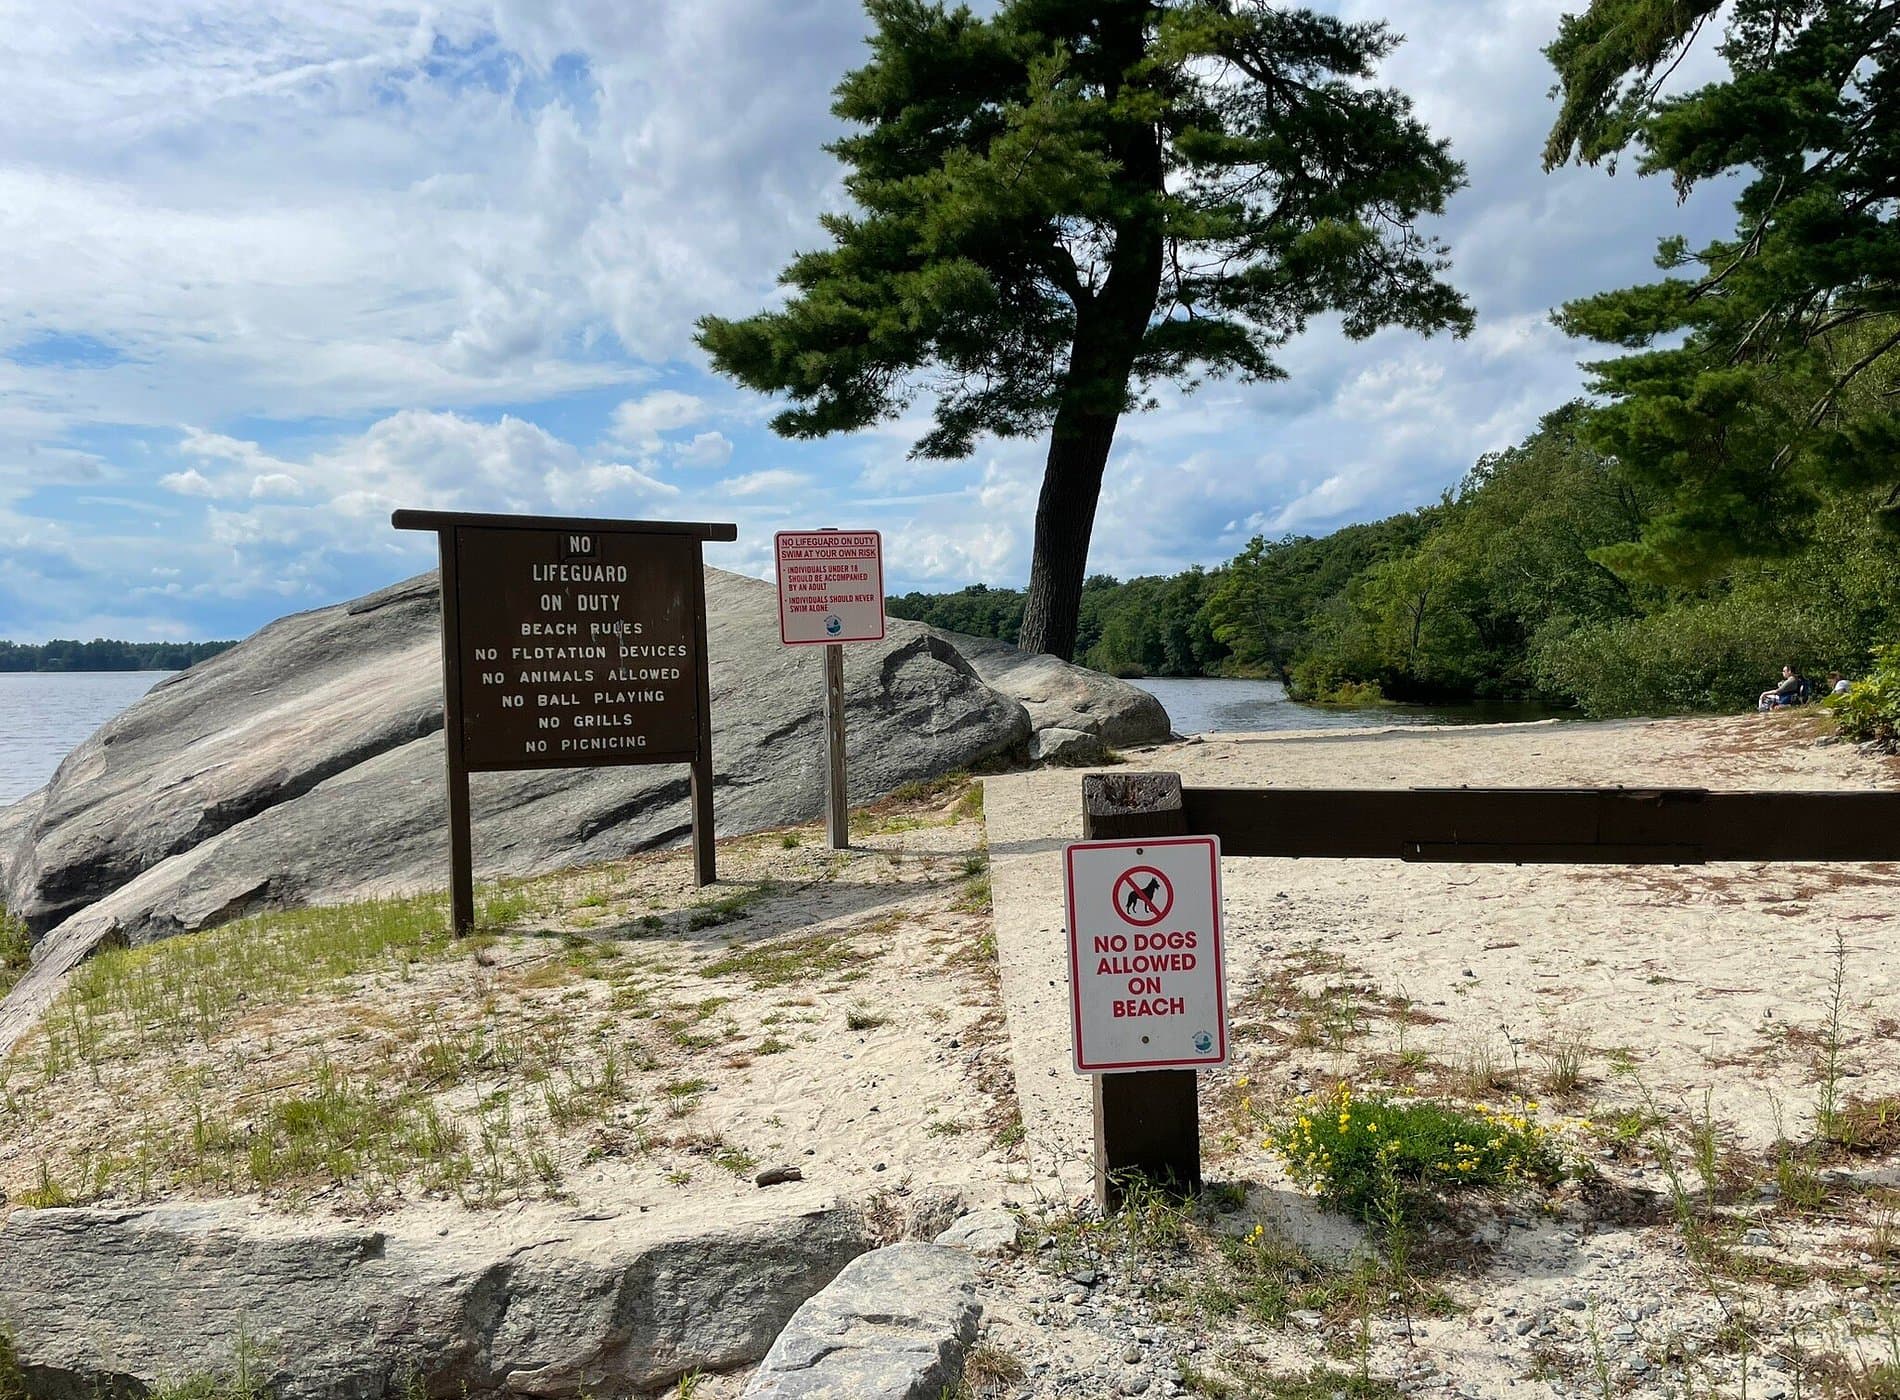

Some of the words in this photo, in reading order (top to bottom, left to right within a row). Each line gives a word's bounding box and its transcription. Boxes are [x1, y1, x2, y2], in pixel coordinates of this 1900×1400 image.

[570, 536, 591, 553] NO
[796, 537, 840, 546] LIFEGUARD
[533, 564, 627, 582] LIFEGUARD
[825, 573, 868, 581] ACCOMPANIED
[541, 594, 562, 611] ON
[578, 594, 620, 611] DUTY
[522, 623, 577, 635] BEACH
[591, 623, 642, 634] RULES
[476, 648, 497, 660] NO
[512, 646, 606, 659] FLOTATION
[619, 645, 687, 657] DEVICES
[482, 672, 504, 685] NO
[520, 670, 593, 683] ANIMALS
[608, 668, 680, 681] ALLOWED
[502, 695, 524, 707] NO
[538, 693, 580, 706] BALL
[595, 690, 664, 703] PLAYING
[538, 716, 559, 728] NO
[574, 714, 633, 727] GRILLS
[526, 740, 547, 752] NO
[561, 736, 646, 751] PICNICING
[1094, 935, 1127, 953] NO
[1135, 932, 1197, 951] DOGS
[1097, 954, 1196, 975] ALLOWED
[1128, 977, 1161, 994] ON
[1113, 998, 1184, 1017] BEACH
